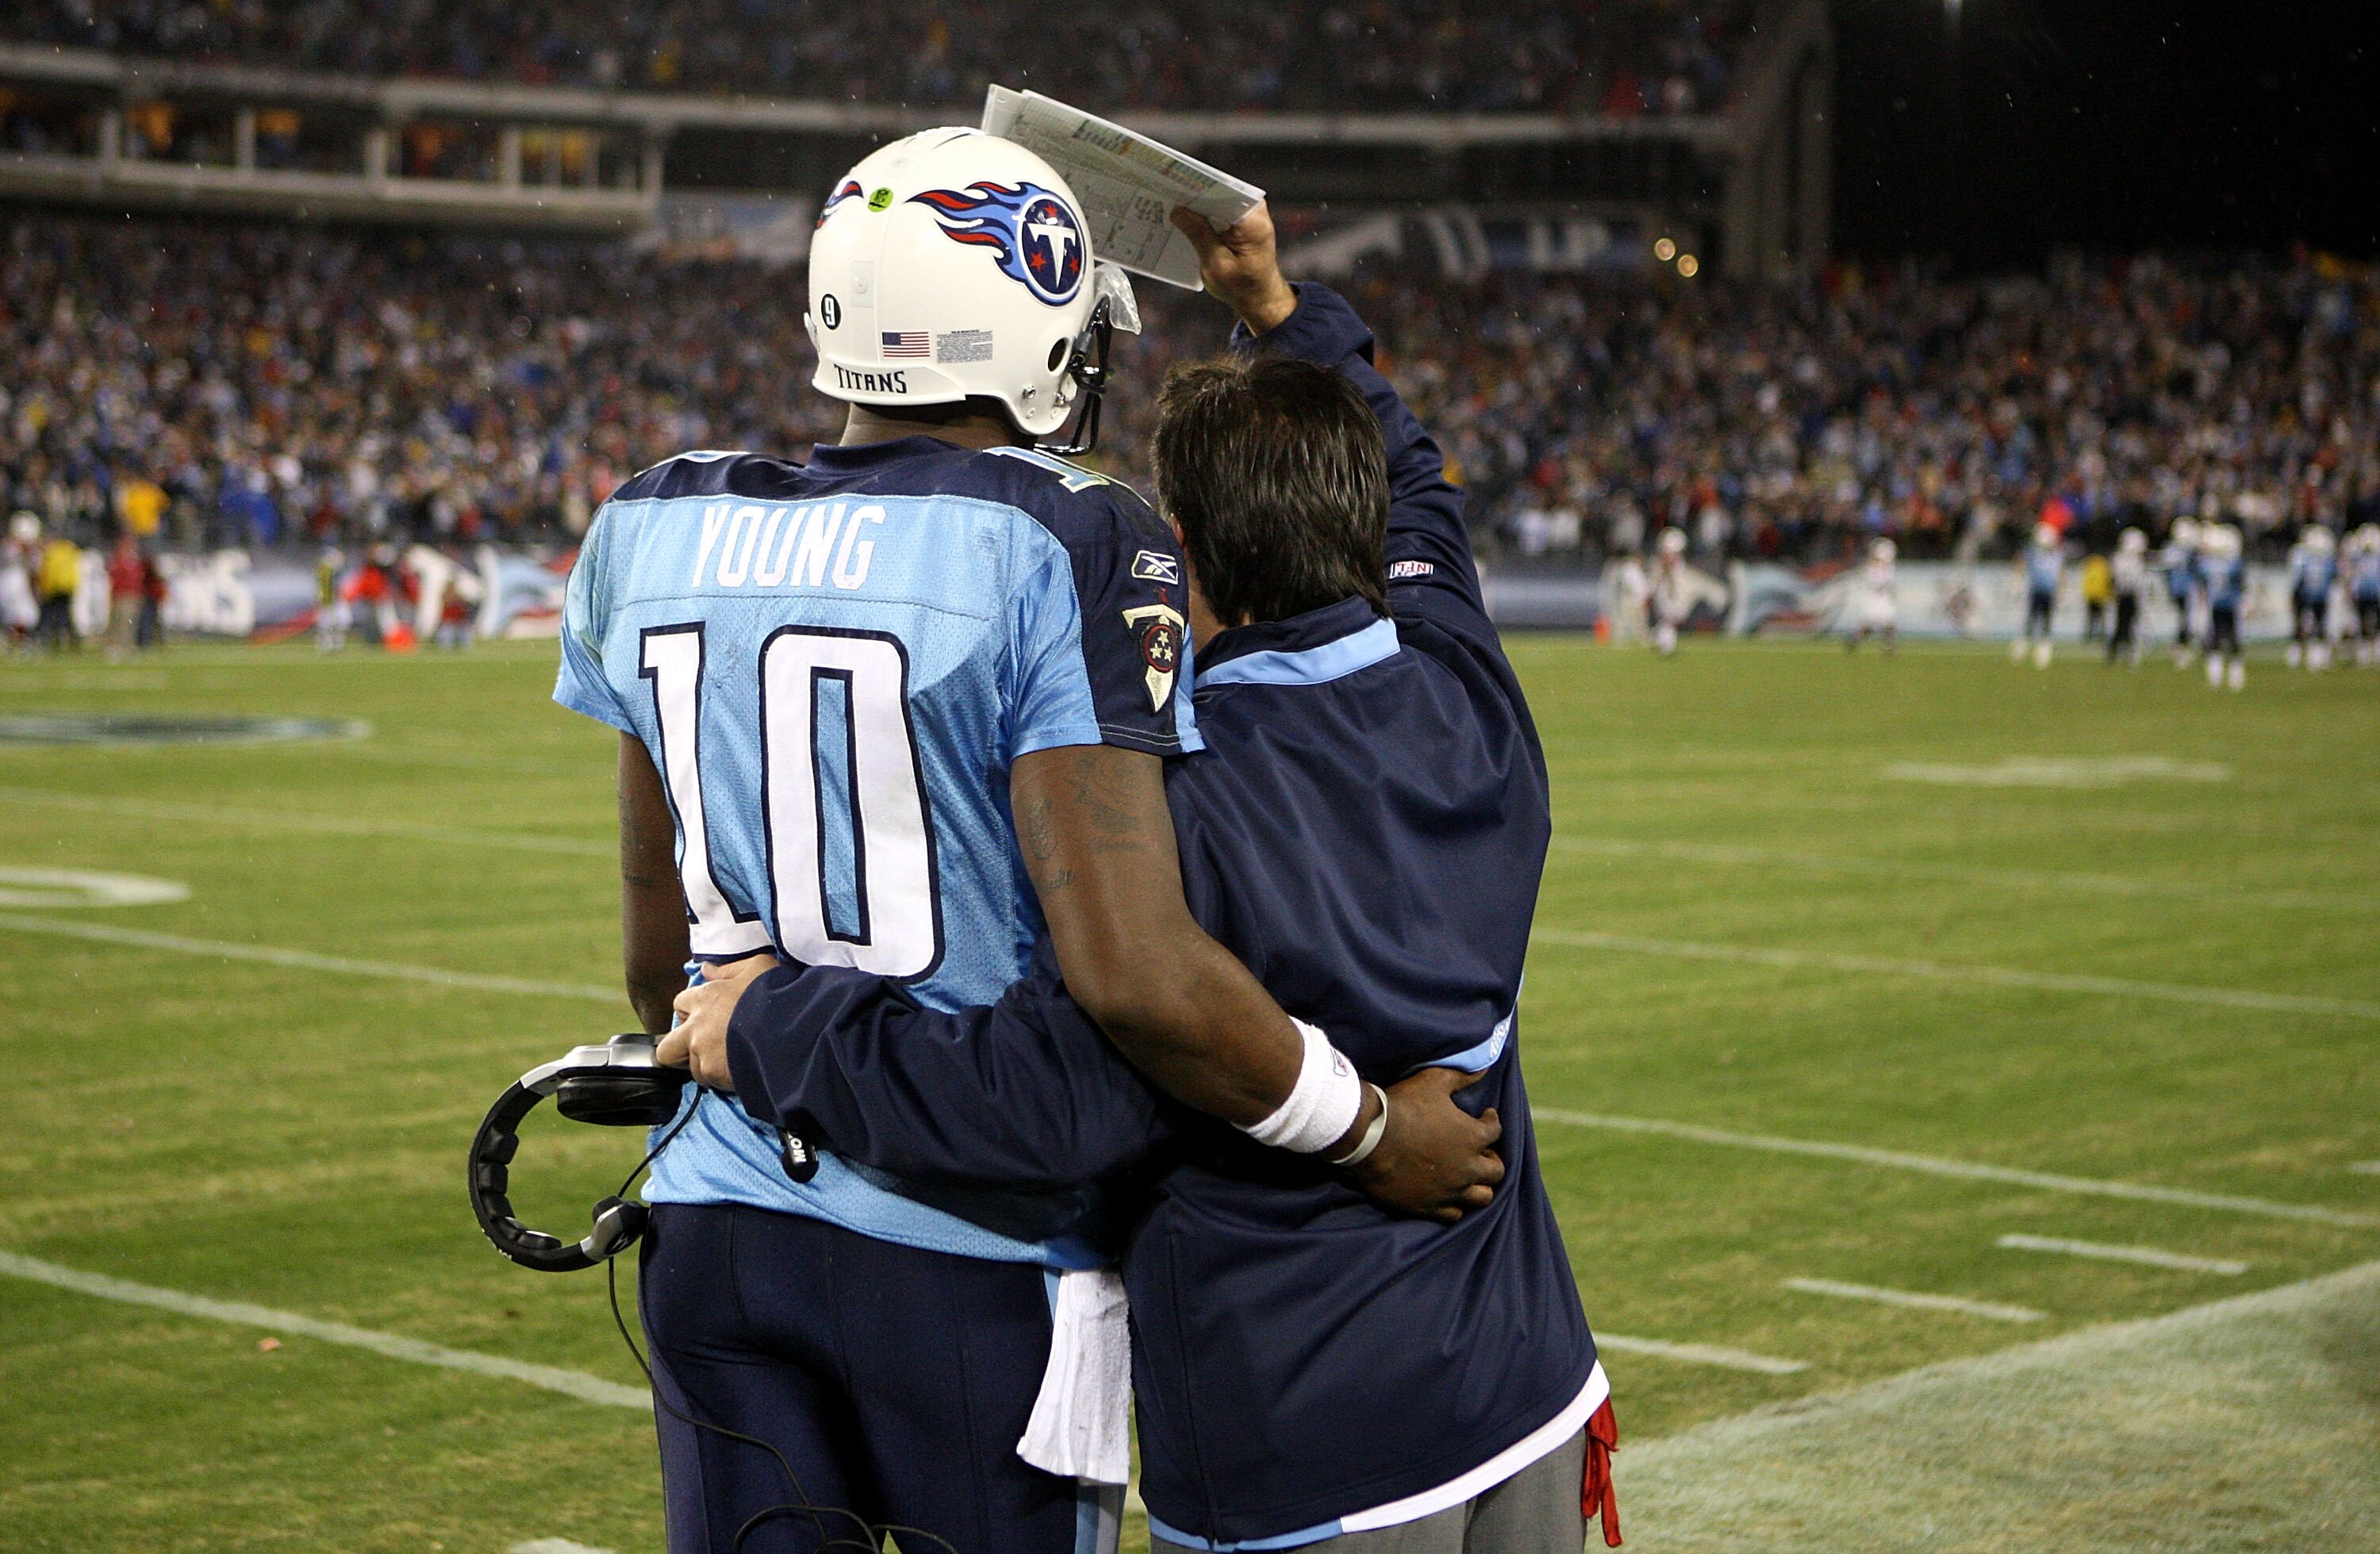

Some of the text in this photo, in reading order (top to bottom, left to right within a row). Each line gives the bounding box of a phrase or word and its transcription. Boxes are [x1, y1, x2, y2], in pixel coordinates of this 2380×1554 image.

[825, 297, 835, 326] 9
[834, 363, 907, 393] TITANS
[693, 504, 886, 590] YOUNG
[639, 621, 946, 984] 10
